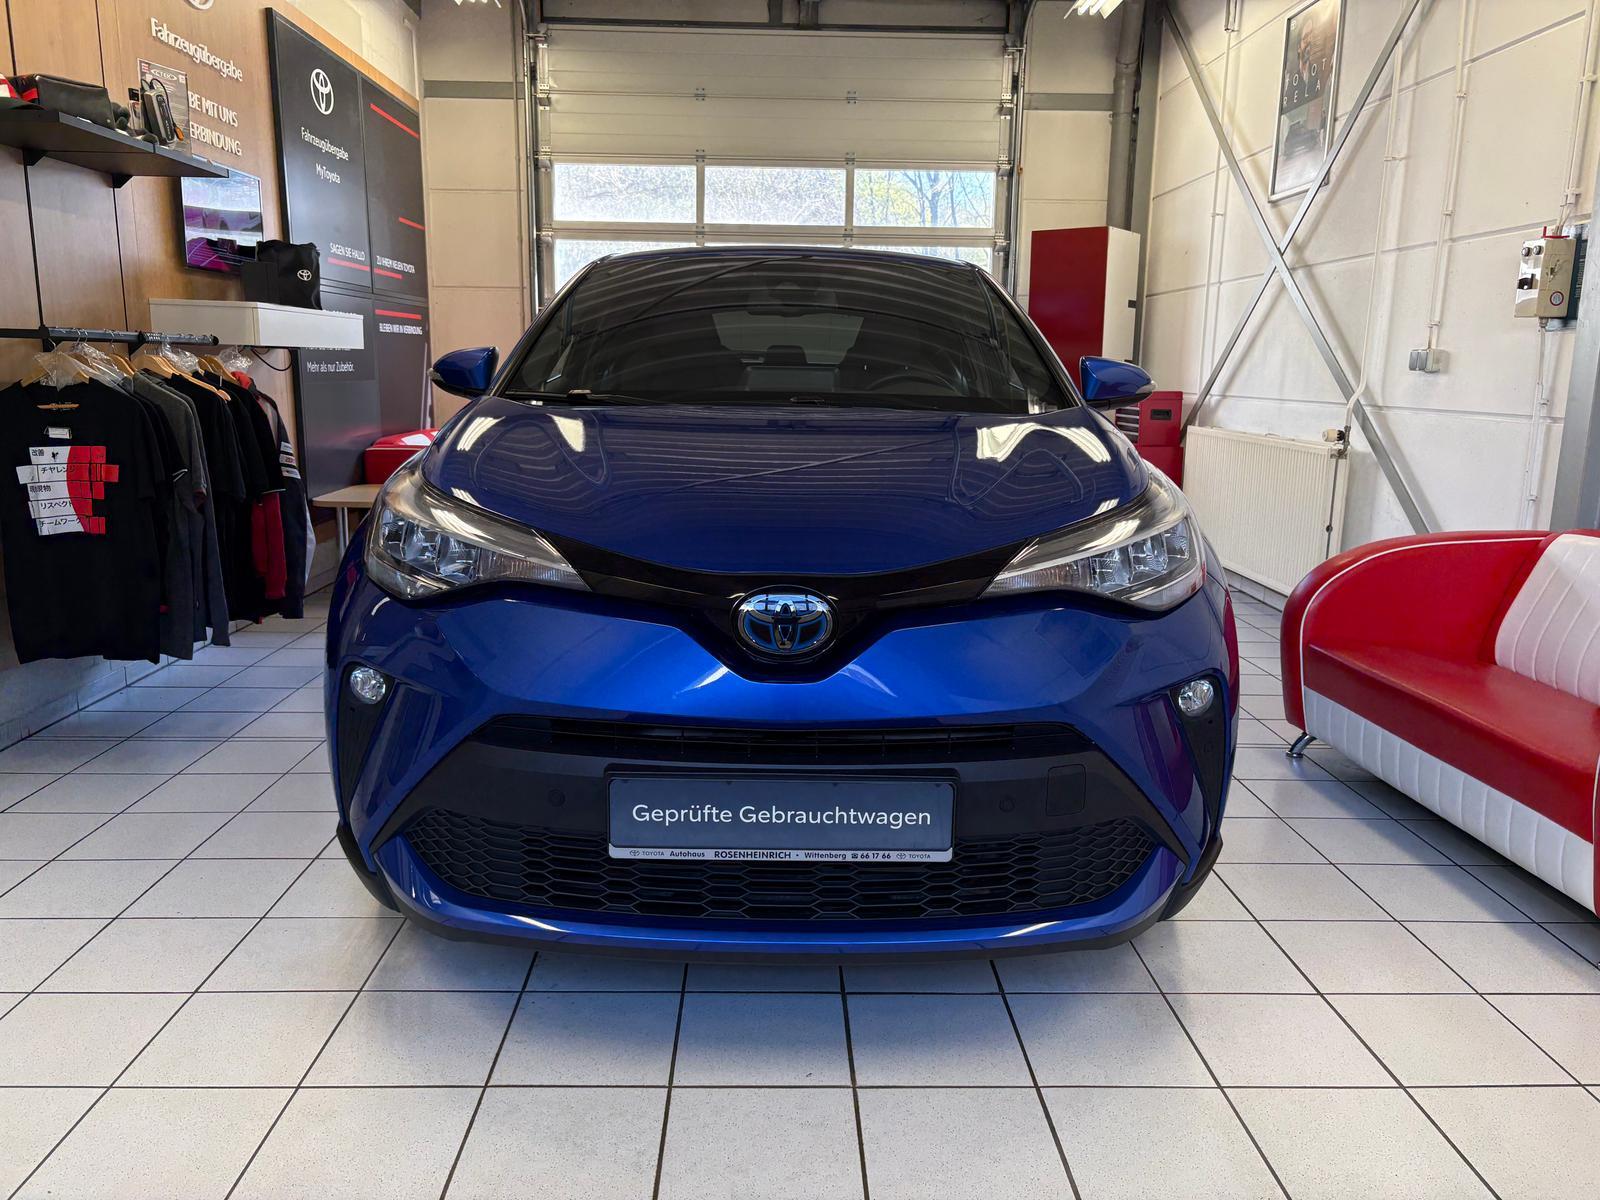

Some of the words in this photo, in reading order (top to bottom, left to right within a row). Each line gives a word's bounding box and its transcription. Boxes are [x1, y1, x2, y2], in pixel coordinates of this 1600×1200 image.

[150, 17, 243, 82] Fahrzeugübergabe
[202, 97, 218, 119] MIT
[219, 105, 238, 128] UNS
[189, 121, 242, 156] ERBINDUNG
[301, 126, 349, 161] Fahrzeugübergabe
[316, 163, 341, 184] MyToyota
[330, 242, 345, 256] SAGEN
[306, 361, 320, 373] Mehr
[328, 363, 336, 373] nur
[632, 803, 732, 826] Geprüfte
[739, 805, 931, 829] Gebrauchtwagen
[669, 850, 706, 858] Autohaus
[714, 850, 792, 860] ROSENHEINRICH
[804, 852, 847, 861] Wittenberg
[860, 852, 870, 860] 66
[872, 852, 880, 860] 17
[881, 852, 892, 860] 66
